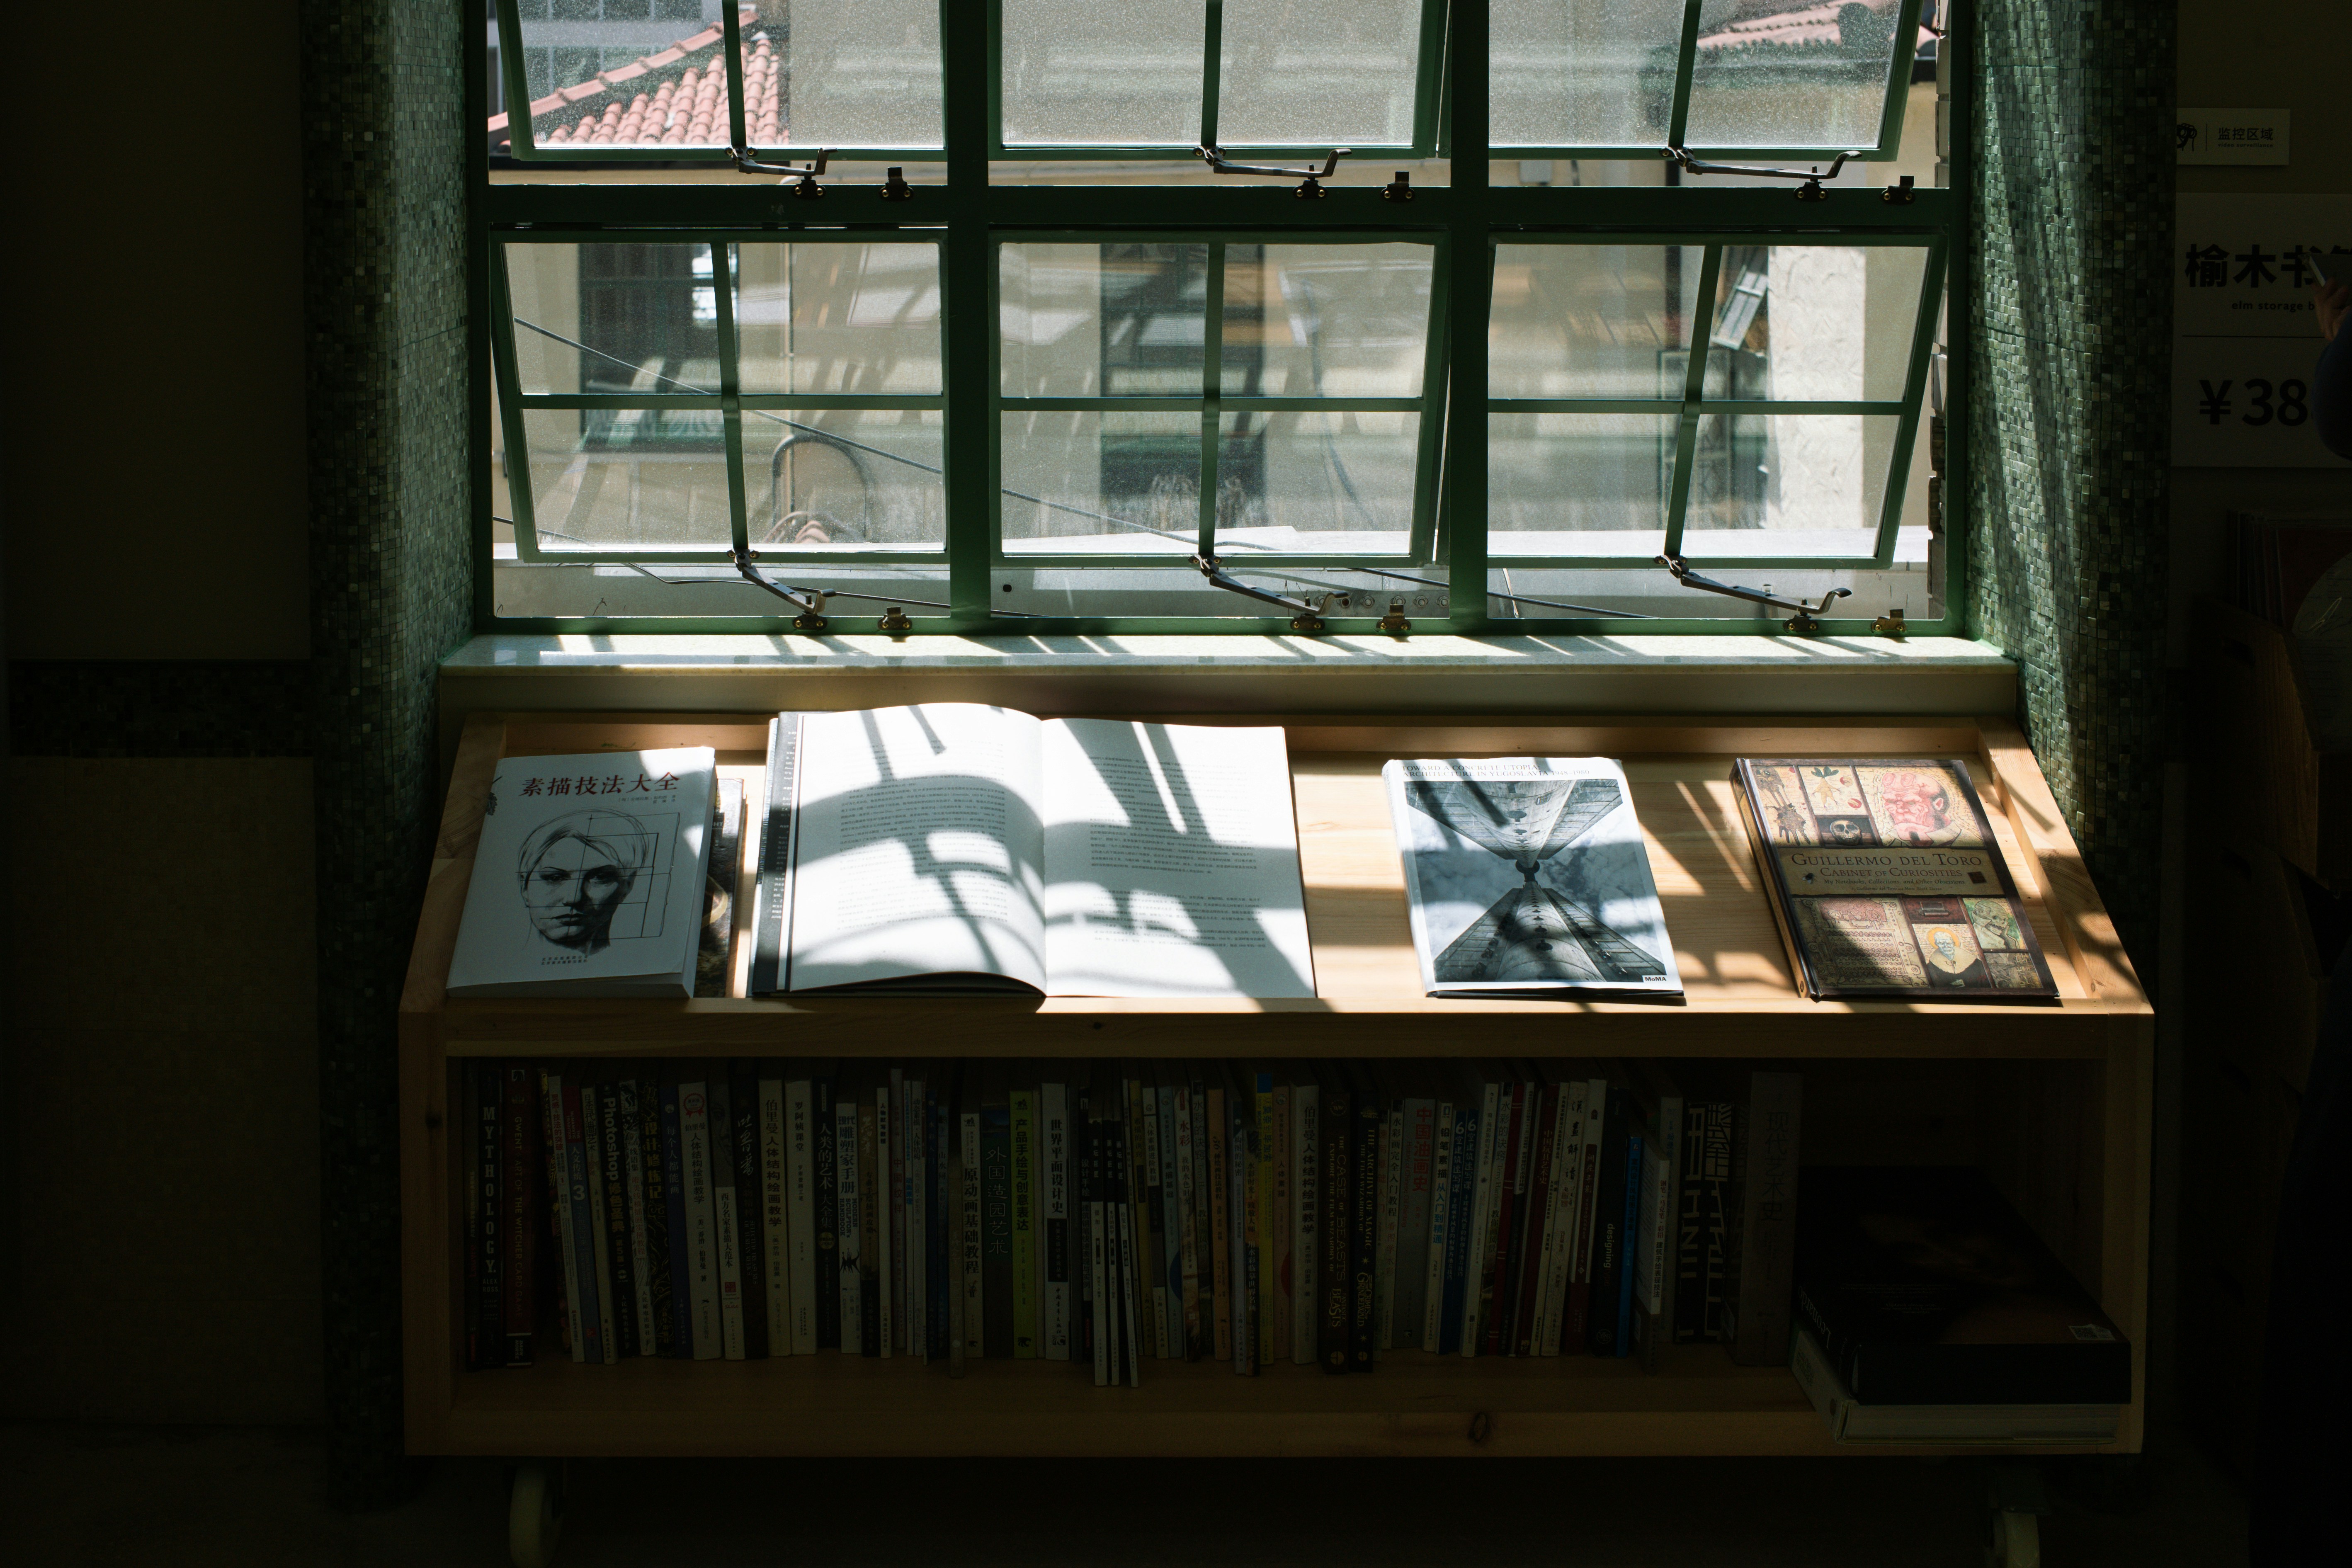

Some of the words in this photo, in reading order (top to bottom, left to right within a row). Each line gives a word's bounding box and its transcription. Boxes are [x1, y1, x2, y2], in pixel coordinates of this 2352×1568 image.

[2218, 127, 2273, 140] 监控区域
[2185, 244, 2352, 288] 榆木书
[2231, 301, 2252, 310] elm
[2258, 301, 2303, 312] storage
[519, 772, 680, 796] 素描技法大全
[1792, 853, 1891, 866] GUILLERMO
[1900, 856, 1930, 866] DEL
[1932, 853, 1982, 866] TORO
[1820, 867, 1871, 877] CABINET
[1889, 868, 1962, 877] CURIOSITIES
[514, 1116, 522, 1151] GWENT
[603, 1097, 621, 1181] Photoshop
[684, 1123, 706, 1132] 伯里曼
[794, 1100, 804, 1152] 罗阿姨课堂
[1147, 1121, 1157, 1183] 人体素描进阶教程
[1178, 1120, 1191, 1146] 水彩
[1193, 1102, 1206, 1160] 水彩的诀窍
[1413, 1107, 1432, 1192] 中国油画史
[1437, 1127, 1450, 1179] 铅笔素描
[1495, 1102, 1510, 1162] 水彩的诀窍
[514, 1160, 522, 1176] ART
[570, 1146, 583, 1181] 人文传统
[629, 1149, 639, 1171] 线语集
[644, 1121, 662, 1199] 设计修炼记
[667, 1125, 680, 1194] 每个人都能画
[691, 1132, 705, 1204] 人体结构绘画教学
[765, 1099, 782, 1227] 伯里曼人体结构绘画教学
[818, 1123, 833, 1189] 人类的艺术
[837, 1115, 856, 1194] 现代雕塑家手册
[1015, 1118, 1029, 1231] 产品手绘与创意表达
[1051, 1119, 1063, 1214] 世界平面设计史
[1081, 1158, 1090, 1196] 设计手绘
[1165, 1161, 1174, 1199] 素描基础
[1182, 1156, 1192, 1206] 我的水色时光
[1233, 1135, 1243, 1177] 构图的秘密
[1302, 1106, 1316, 1234] 伯里曼人体结构绘画教学
[1337, 1154, 1347, 1198] CASE
[1366, 1151, 1374, 1197] ARCHIVE
[1388, 1117, 1402, 1216] 水彩画完全入门教程
[1450, 1121, 1465, 1193] 6堂建筑速写课
[1463, 1119, 1477, 1191] 6堂建筑速写课
[1537, 1129, 1553, 1185] 中国玩具艺术史
[1762, 1112, 1790, 1221] 现代艺术史
[515, 1178, 522, 1192] OF
[572, 1184, 585, 1201] 3
[607, 1182, 625, 1233] 修色圣典
[819, 1194, 833, 1228] 大全集
[893, 1158, 903, 1214] 中国纹样
[985, 1146, 1009, 1255] 外国造园艺术
[1339, 1201, 1344, 1212] OF
[1366, 1199, 1373, 1212] OF
[1656, 1180, 1667, 1238] 钢笔·马克笔·彩铅
[721, 1192, 734, 1268] 西方名家素描大范本
[964, 1168, 979, 1274] 原动画基础教程
[1364, 1216, 1373, 1250] MAGIC
[1432, 1183, 1446, 1244] 从入门到精通
[1082, 1201, 1090, 1289] 建筑钢笔快速表现与实例
[1337, 1216, 1346, 1281] BEASTS
[1603, 1223, 1615, 1269] designing
[1653, 1241, 1664, 1298] 建筑手绘表现技法
[1247, 1240, 1257, 1312] 用水彩临摹世界名画
[1357, 1272, 1369, 1328] GRINDELWALD
[1364, 1289, 1372, 1315] CRIMES
[642, 1290, 651, 1336] 人民邮电出版社
[1329, 1288, 1342, 1328] BEASTS
[1797, 1286, 1831, 1350] Leonardo
